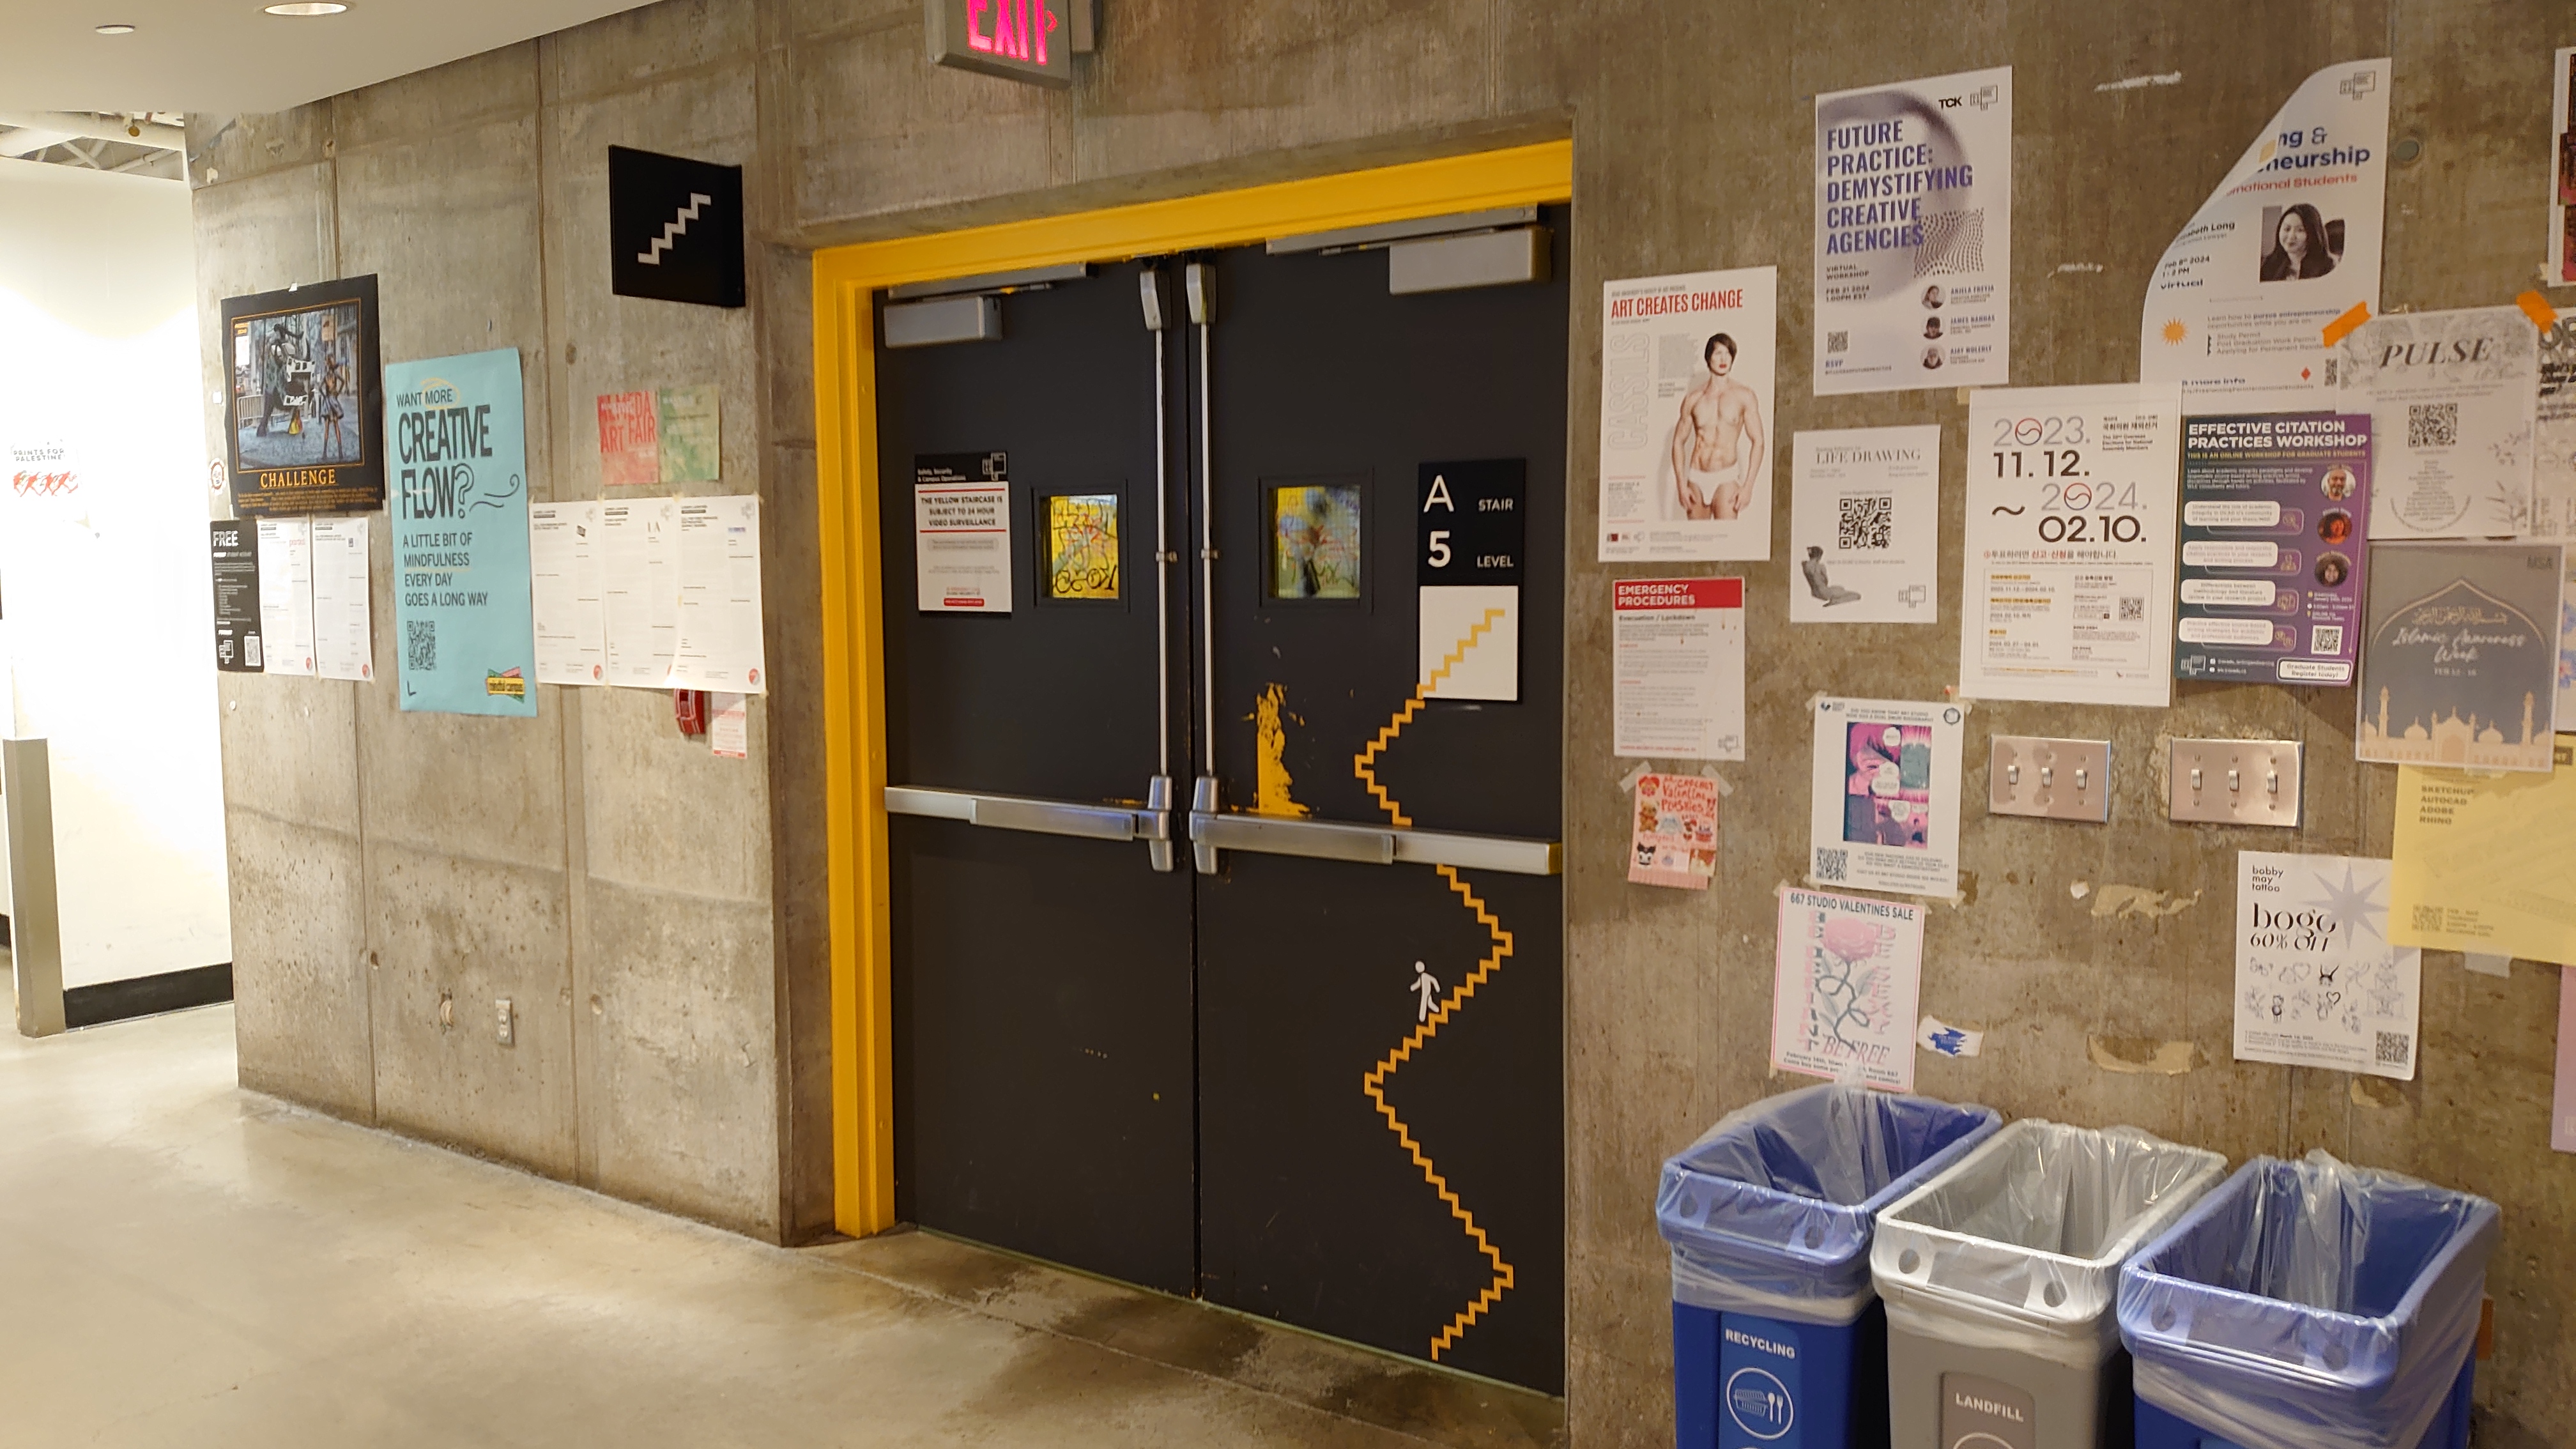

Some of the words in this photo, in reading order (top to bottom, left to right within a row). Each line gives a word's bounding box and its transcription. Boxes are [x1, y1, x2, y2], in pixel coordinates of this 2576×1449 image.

[1938, 96, 1962, 109] TCK
[1827, 120, 1903, 151] FUTURE
[1827, 143, 1933, 178] PRACTICE:
[1827, 165, 1973, 203] DEMYSTIFYING
[2294, 172, 2358, 187] Students
[1827, 197, 1922, 229] CREATIVE
[1827, 224, 1924, 255] AGENCIES
[1827, 263, 1857, 272] VIRTUAL
[1827, 270, 1869, 280] WORKSHOP
[2161, 279, 2203, 289] virtual
[1611, 298, 1634, 319] ART
[1636, 293, 1689, 316] CREATES
[1692, 289, 1744, 312] CHANGE
[2379, 337, 2494, 370] PULSE
[396, 392, 423, 408] WANT
[425, 388, 453, 404] MORE
[398, 404, 493, 464] CREATIVE
[628, 416, 656, 445] FAIR
[2189, 422, 2271, 435] EFFECTIVE
[2275, 420, 2345, 434] CITATION
[600, 425, 624, 454] ART
[2188, 436, 2273, 449] PRACTICES
[2276, 434, 2367, 448] WORKSHOP
[1816, 450, 1849, 464] LIFE
[1852, 448, 1921, 464] DRAWING
[260, 469, 336, 488] CHALLENGE
[401, 463, 475, 520] FLOW?
[1423, 474, 1455, 513] A
[1478, 498, 1514, 512] STAIR
[213, 530, 239, 547] FREE
[402, 534, 409, 548] A
[411, 533, 440, 548] LITTLE
[443, 533, 457, 546] BIT
[459, 532, 473, 546] OF
[1428, 530, 1451, 568] 5
[1476, 555, 1514, 568] LEVEL
[404, 553, 470, 567] MINDFULNESS
[404, 573, 433, 587] EVERY
[435, 572, 453, 586] DAY
[1618, 584, 1689, 595] EMERGENCY
[405, 592, 429, 606] GOES
[431, 593, 437, 606] A
[440, 592, 465, 606] LONG
[468, 592, 488, 606] WAY
[1618, 595, 1695, 606] PROCEDURES
[2421, 785, 2474, 795] SKETCHUP
[2421, 795, 2467, 806] AUTOCAD
[2419, 806, 2454, 815] ADOBE
[2419, 816, 2452, 825] RHINO
[2252, 864, 2284, 878] bobby
[2252, 875, 2273, 885] may
[2252, 883, 2280, 892] tattoo
[1791, 893, 1805, 906] 667
[1807, 895, 1837, 910] STUDIO
[1839, 900, 1890, 918] VALENTINES
[1892, 907, 1914, 921] SALE
[2250, 933, 2288, 950] 60%
[1725, 1328, 1795, 1359] RECYCLING
[1955, 1393, 2025, 1423] LANDFILL
